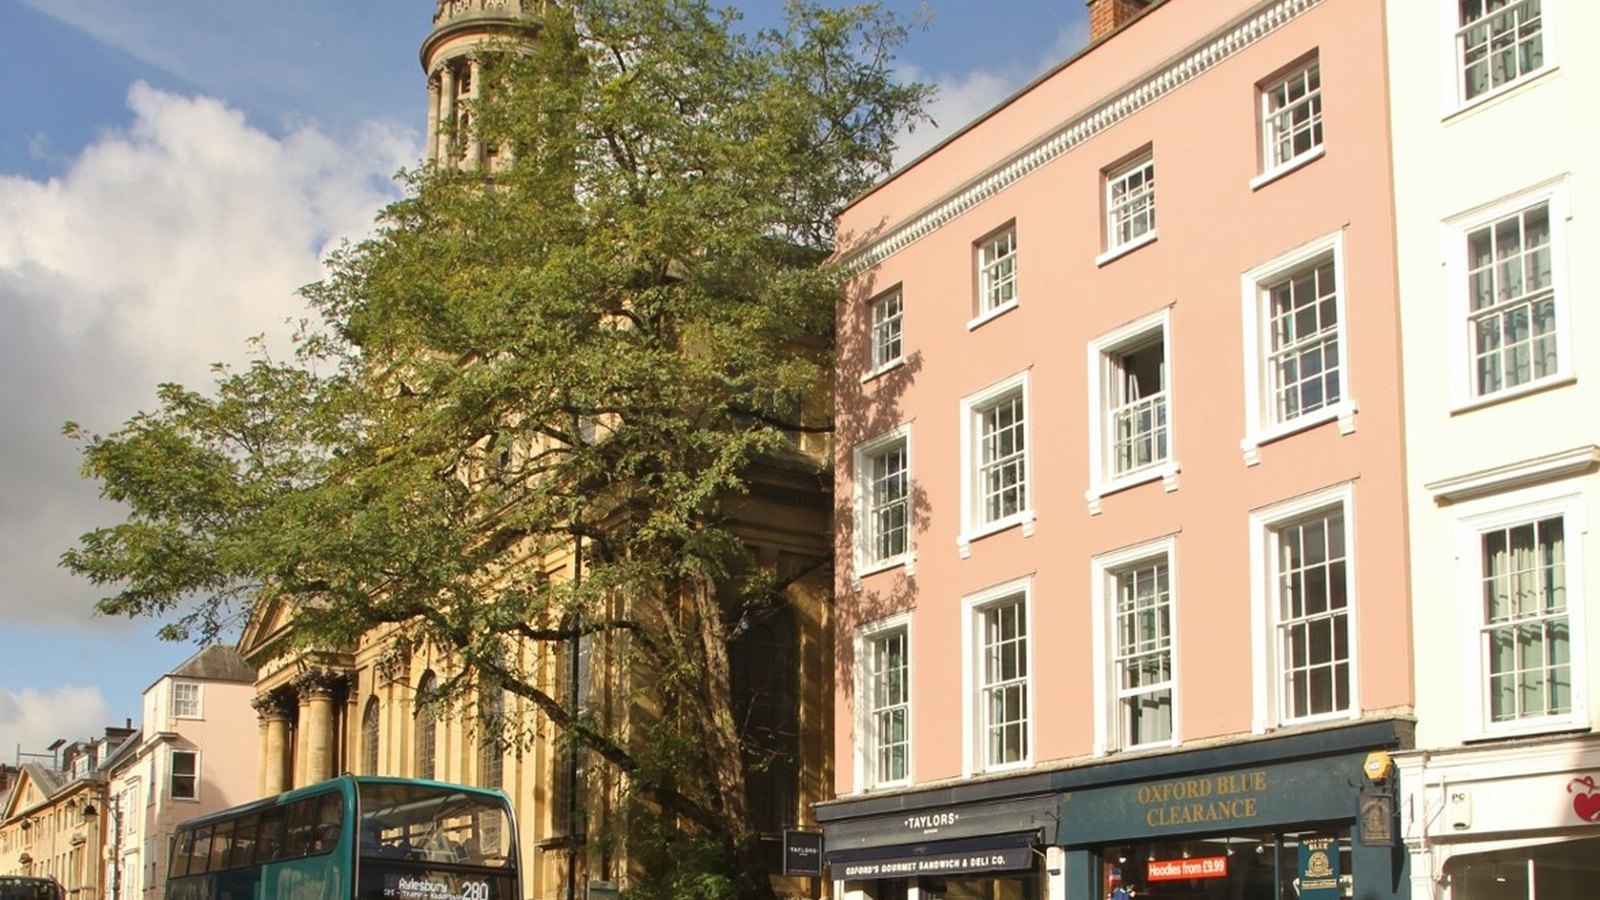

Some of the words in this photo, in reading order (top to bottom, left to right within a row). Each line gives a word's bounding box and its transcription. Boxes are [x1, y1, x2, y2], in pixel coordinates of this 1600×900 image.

[1137, 779, 1212, 804] OXFORD
[1217, 771, 1267, 795] BLUE
[908, 812, 955, 829] TAYLORS
[1146, 798, 1257, 828] CLEARANCE
[881, 861, 917, 873] GOURMET
[918, 858, 960, 870] SANDWICH
[961, 858, 968, 868] &
[970, 856, 989, 867] DELI
[991, 855, 1006, 865] CO.
[1148, 863, 1181, 877] Hoodies
[1182, 862, 1202, 874] from
[1202, 859, 1225, 873] £9.99
[398, 877, 448, 892] Aylesbury
[461, 881, 489, 900] 280
